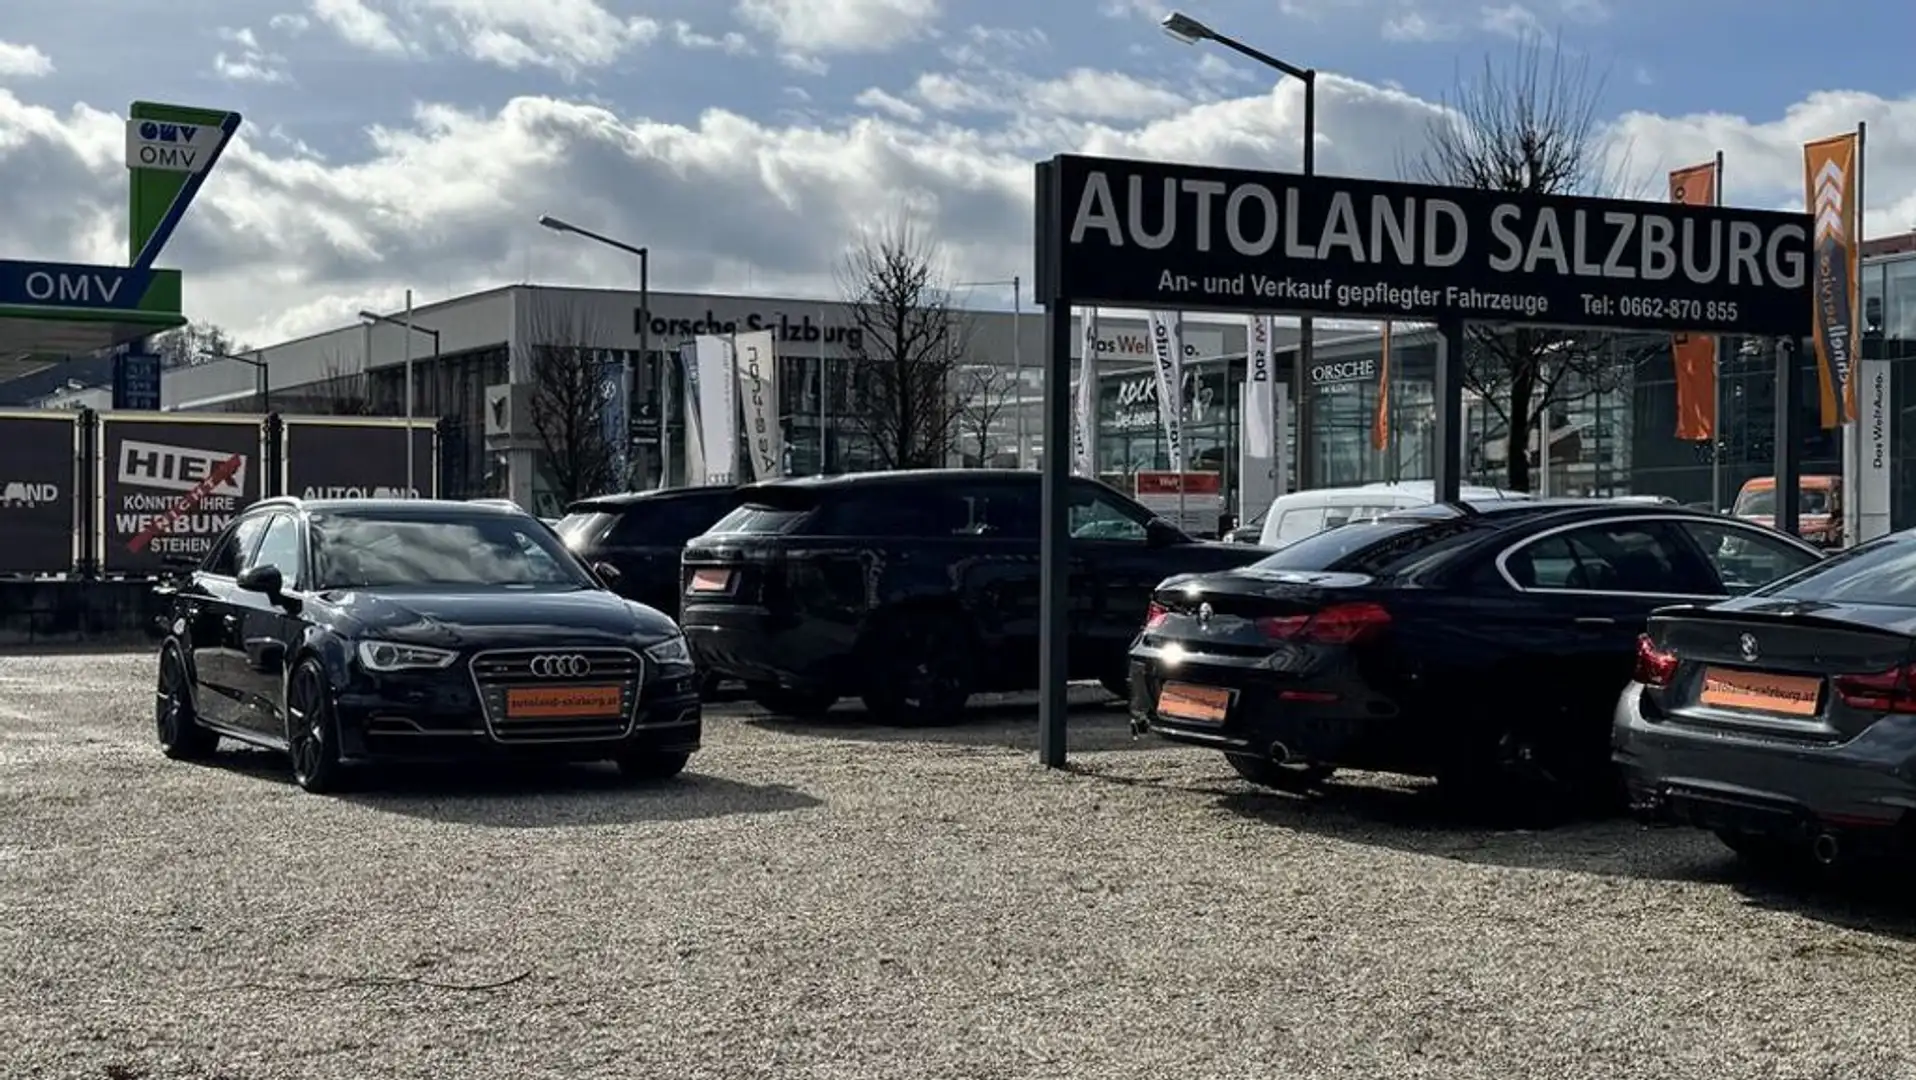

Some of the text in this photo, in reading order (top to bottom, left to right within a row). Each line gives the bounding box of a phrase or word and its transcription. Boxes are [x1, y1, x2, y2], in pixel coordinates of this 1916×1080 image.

[140, 146, 195, 167] OMV
[1070, 171, 1806, 289] AUTOLAND SALZBURG
[26, 271, 123, 302] OMV
[1158, 269, 1738, 322] An- und Verkauf gepflegter Fahrzeuge Tel: 0662-870 855
[633, 307, 736, 337] Porsche
[1311, 359, 1375, 381] ORSCHE
[1873, 443, 1883, 468] Das
[200, 496, 235, 511] IHRE
[116, 513, 232, 533] WERBUN
[150, 537, 211, 552] STEHEN
